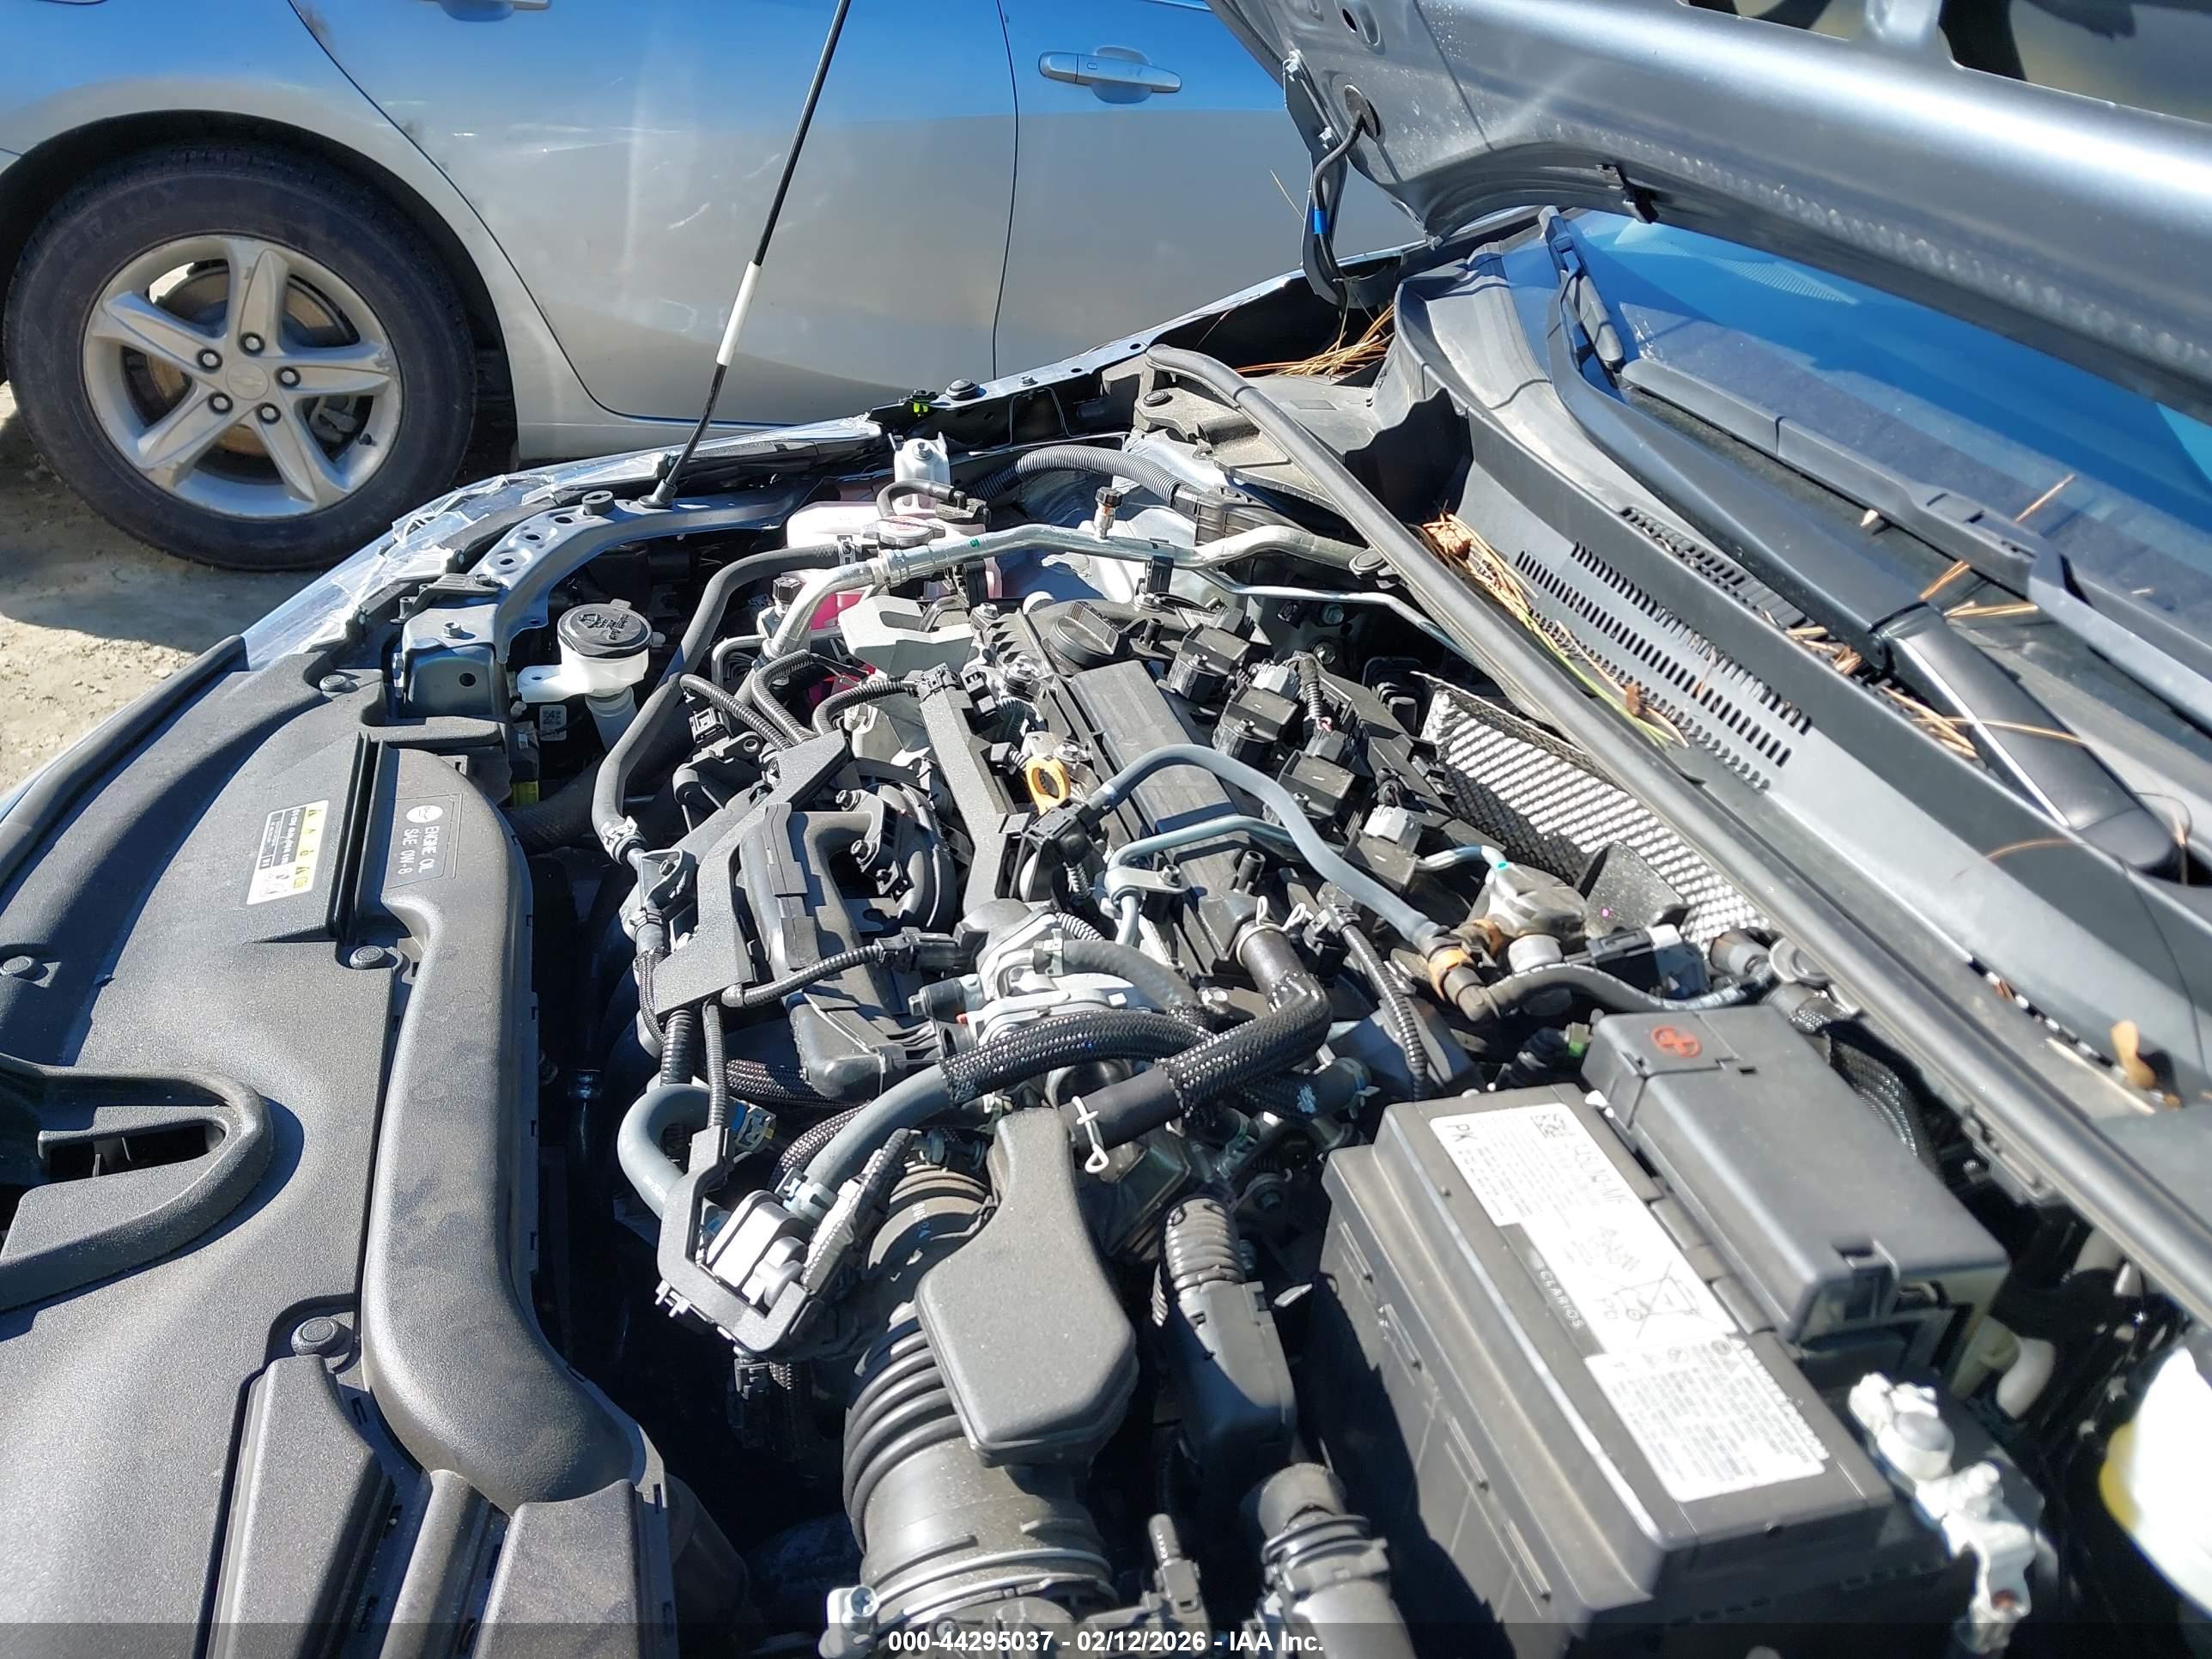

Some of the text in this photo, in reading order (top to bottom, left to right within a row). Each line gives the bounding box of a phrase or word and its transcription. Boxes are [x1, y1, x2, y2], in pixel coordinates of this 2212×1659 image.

[403, 829, 419, 846] SAE
[418, 826, 440, 873] ENGINE OIL
[1540, 1270, 1584, 1329] CLARIOS
